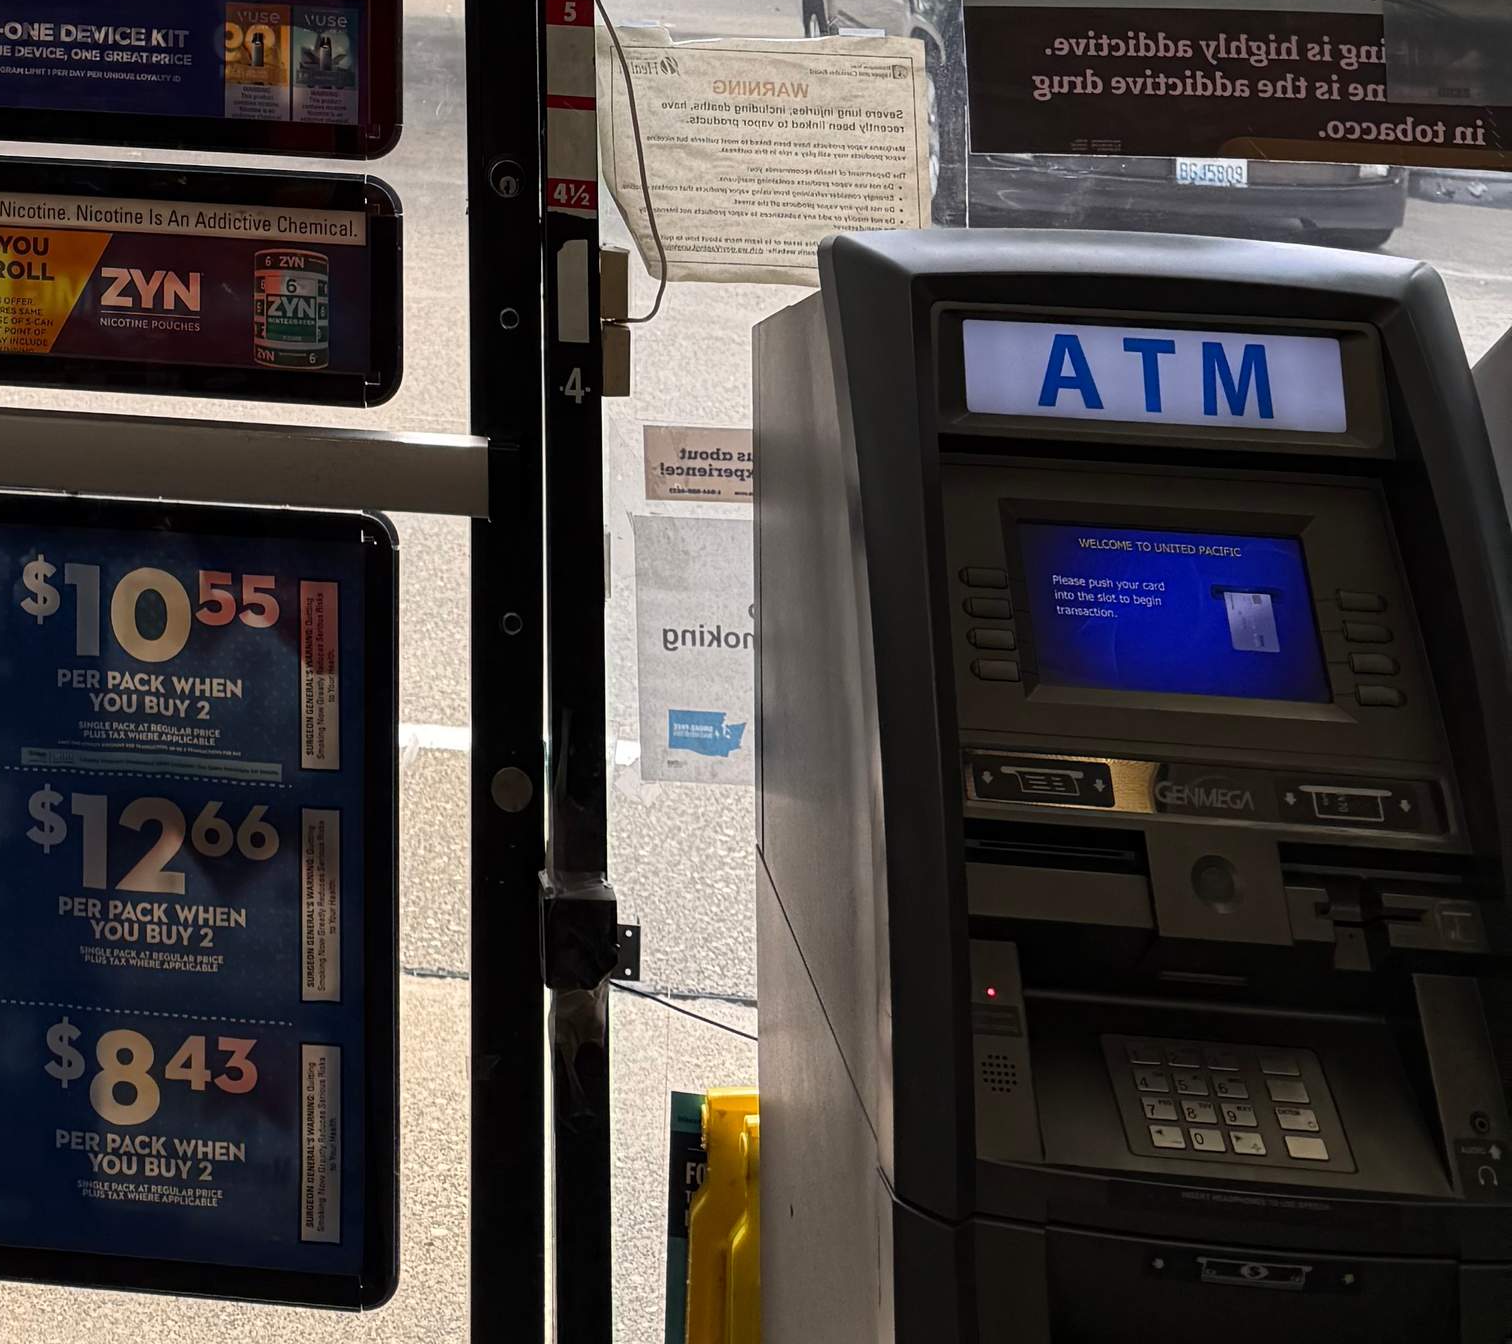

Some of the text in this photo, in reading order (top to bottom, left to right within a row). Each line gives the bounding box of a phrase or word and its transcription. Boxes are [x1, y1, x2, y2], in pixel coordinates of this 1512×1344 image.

[58, 23, 147, 47] DEVICE
[150, 28, 190, 50] KIT
[0, 200, 71, 221] Nicotine.
[76, 204, 144, 225] Nicotine
[149, 208, 162, 226] Is
[167, 210, 190, 228] An
[194, 211, 272, 232] Addictive
[277, 215, 358, 238] Chemical.
[100, 266, 201, 312] ZYN
[99, 318, 201, 333] NICOTINE POUCHES
[1037, 333, 1275, 419] ATM
[1077, 537, 1243, 557] WELCOME TO UNITED PACIFIC
[1051, 573, 1166, 592] Please push your card
[1055, 605, 1119, 619] transaction.
[56, 668, 243, 700] PER PACK WHEN
[89, 692, 211, 720] YOU BUY 2
[1155, 780, 1255, 811] GENMEGA
[55, 1128, 246, 1162] PER PACK WHEN
[88, 1152, 213, 1181] YOU BUY 2
